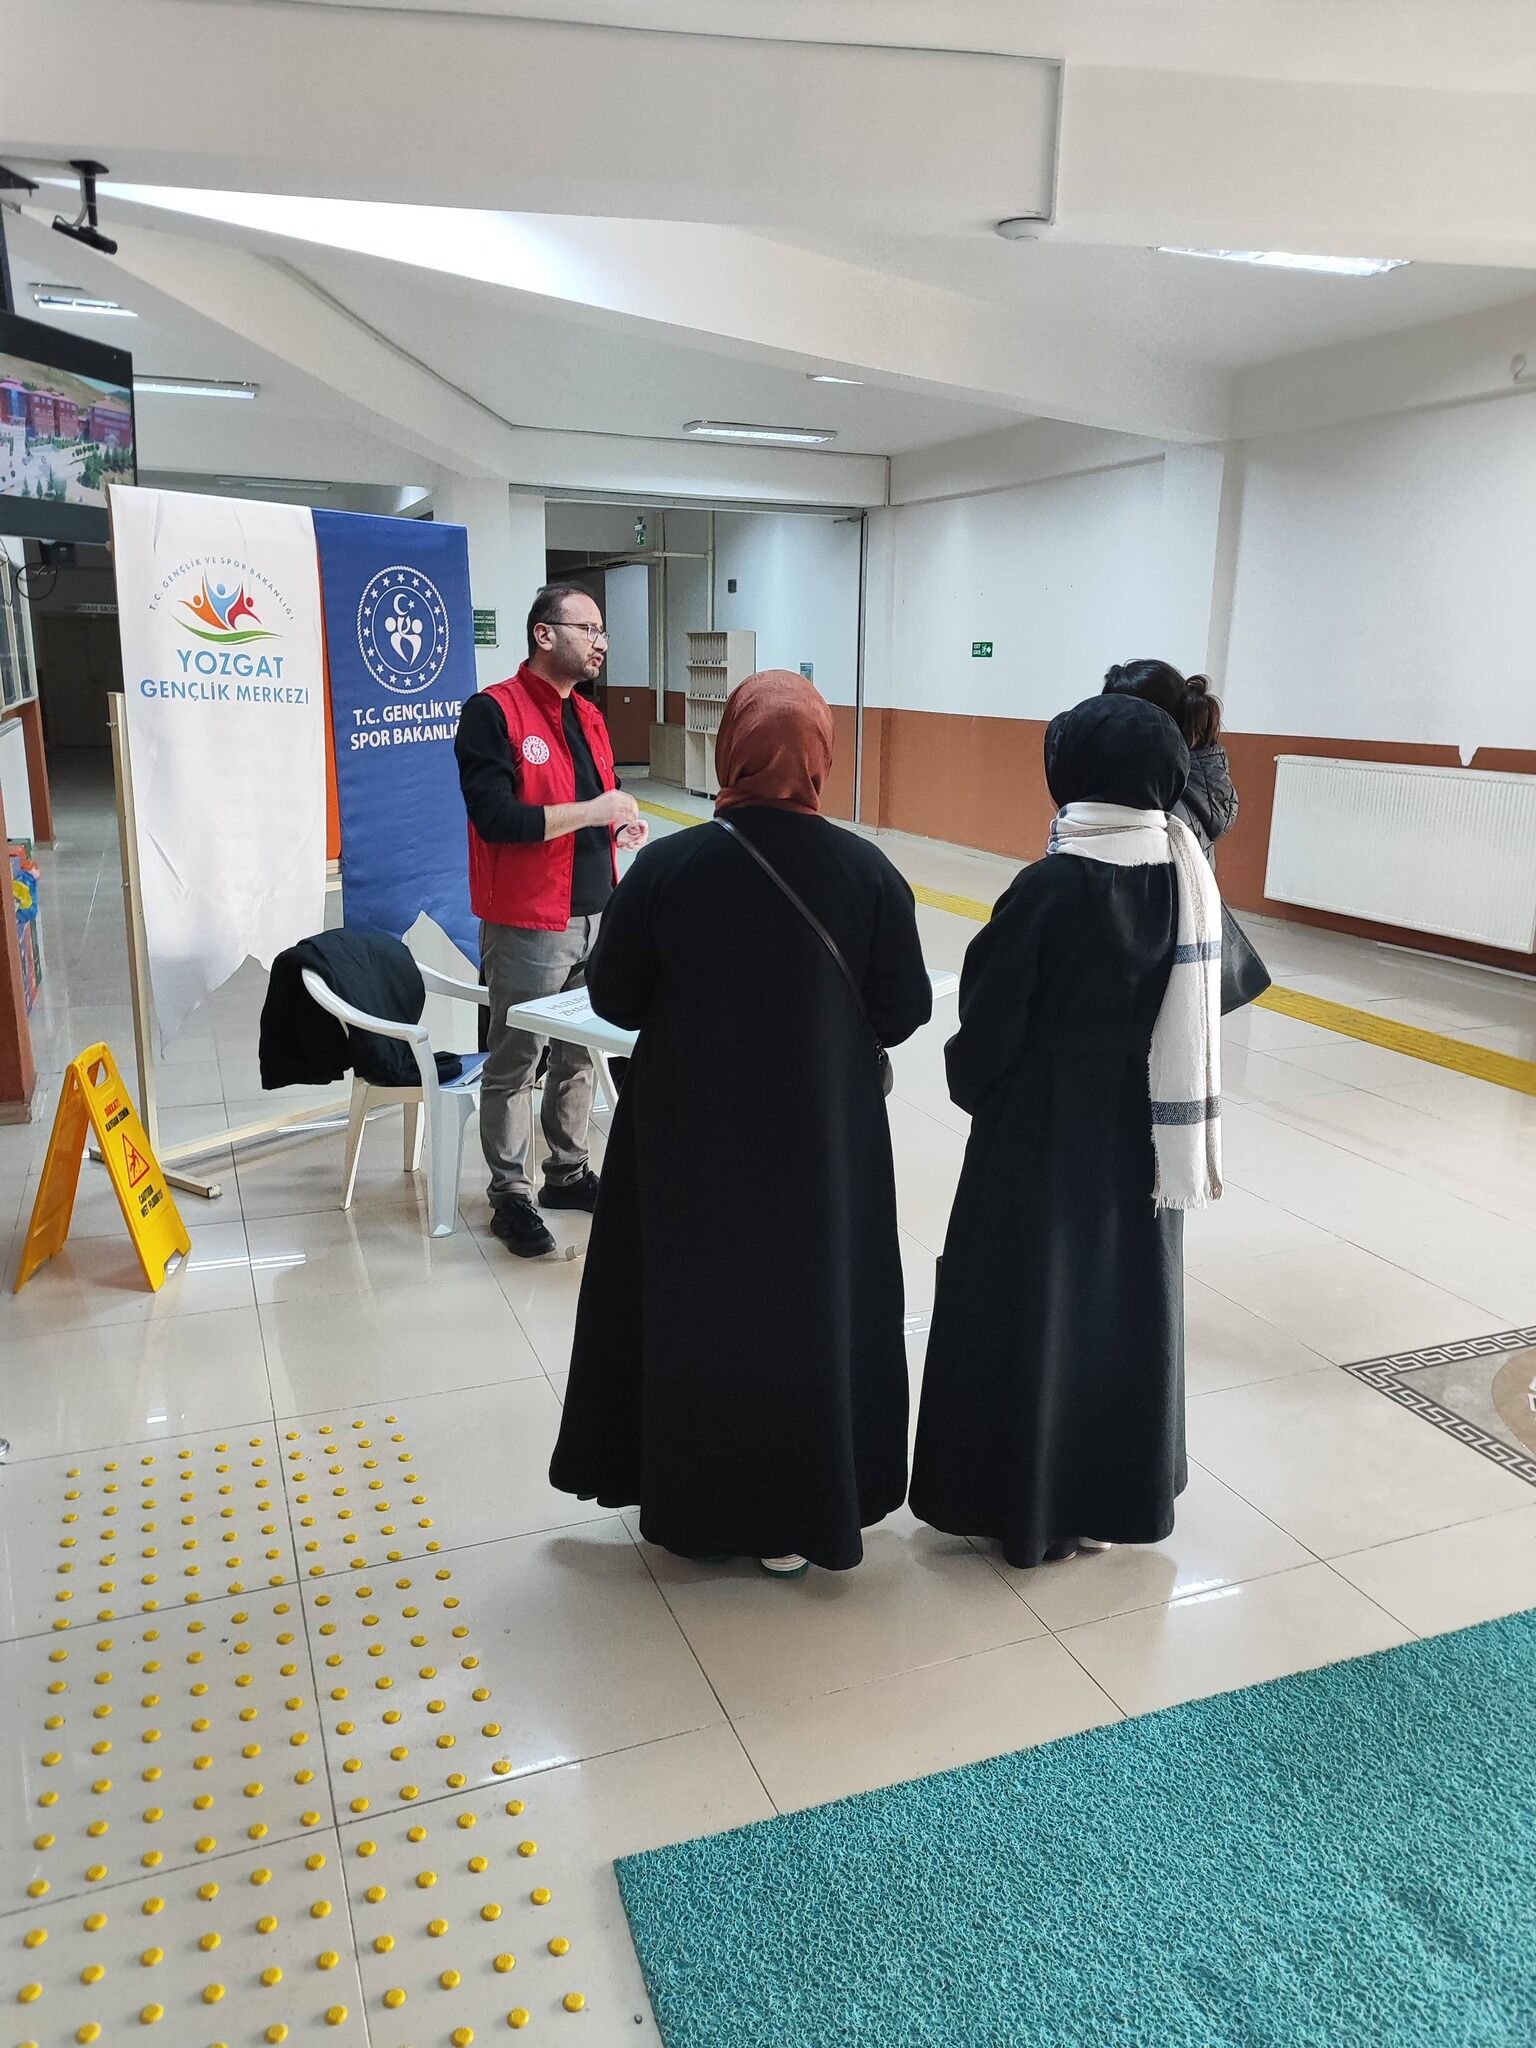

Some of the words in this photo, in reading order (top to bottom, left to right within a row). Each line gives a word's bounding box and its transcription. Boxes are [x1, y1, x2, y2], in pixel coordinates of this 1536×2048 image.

[162, 558, 201, 589] GENÇLİK
[220, 557, 247, 571] SPOR
[249, 567, 296, 621] BAKANLIĞI
[176, 649, 284, 679] YOZGAT
[140, 679, 232, 702] GENÇLİK
[236, 685, 309, 705] MERKEZİ
[353, 707, 380, 726] T.C.
[382, 699, 445, 724] GENÇLİK
[445, 700, 462, 717] VE
[350, 729, 391, 751] SPOR
[393, 719, 460, 745] BAKANLIĞ
